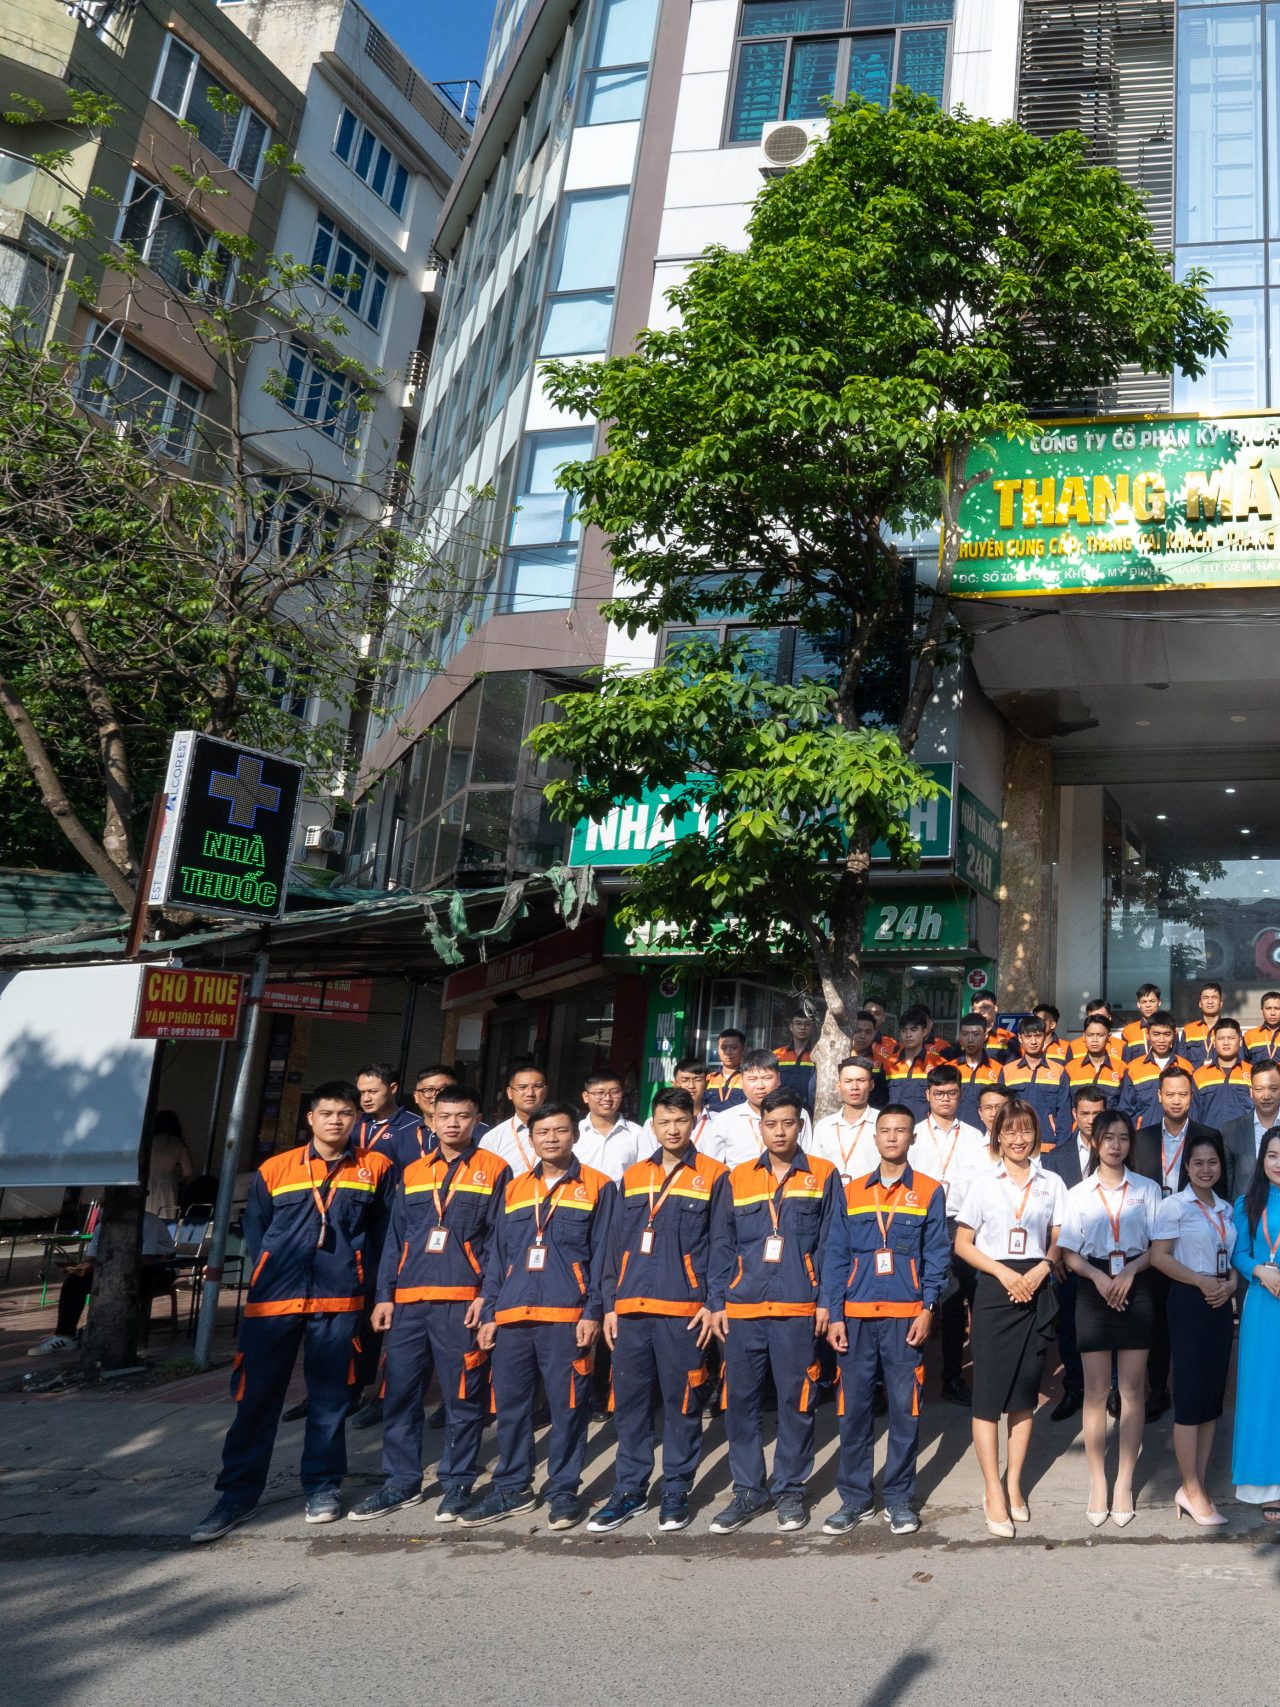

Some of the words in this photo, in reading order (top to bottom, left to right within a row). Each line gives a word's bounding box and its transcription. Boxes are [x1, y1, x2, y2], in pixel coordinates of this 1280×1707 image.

[1030, 430, 1077, 454] CÔNG
[1086, 433, 1107, 452] TY
[1112, 424, 1136, 451] CỔ
[993, 471, 1167, 529] THANG
[958, 536, 1004, 560] HUYÊN
[1006, 537, 1044, 558] CUNG
[1086, 534, 1132, 554] THANG
[1166, 527, 1213, 554] KHÁCH
[1227, 530, 1275, 551] THANG
[584, 793, 677, 852] NHÀ
[961, 799, 977, 836] NHÀ
[202, 830, 266, 868] NHÀ
[966, 842, 992, 890] 24H
[180, 866, 278, 908] THUỐC
[874, 905, 943, 940] 24h
[147, 972, 189, 1003] CHO
[193, 974, 240, 1005] THUÊ
[486, 955, 509, 987] Mini
[145, 1008, 167, 1024] VĂN
[168, 1009, 201, 1025] PHÒNG
[229, 1014, 235, 1026] 1
